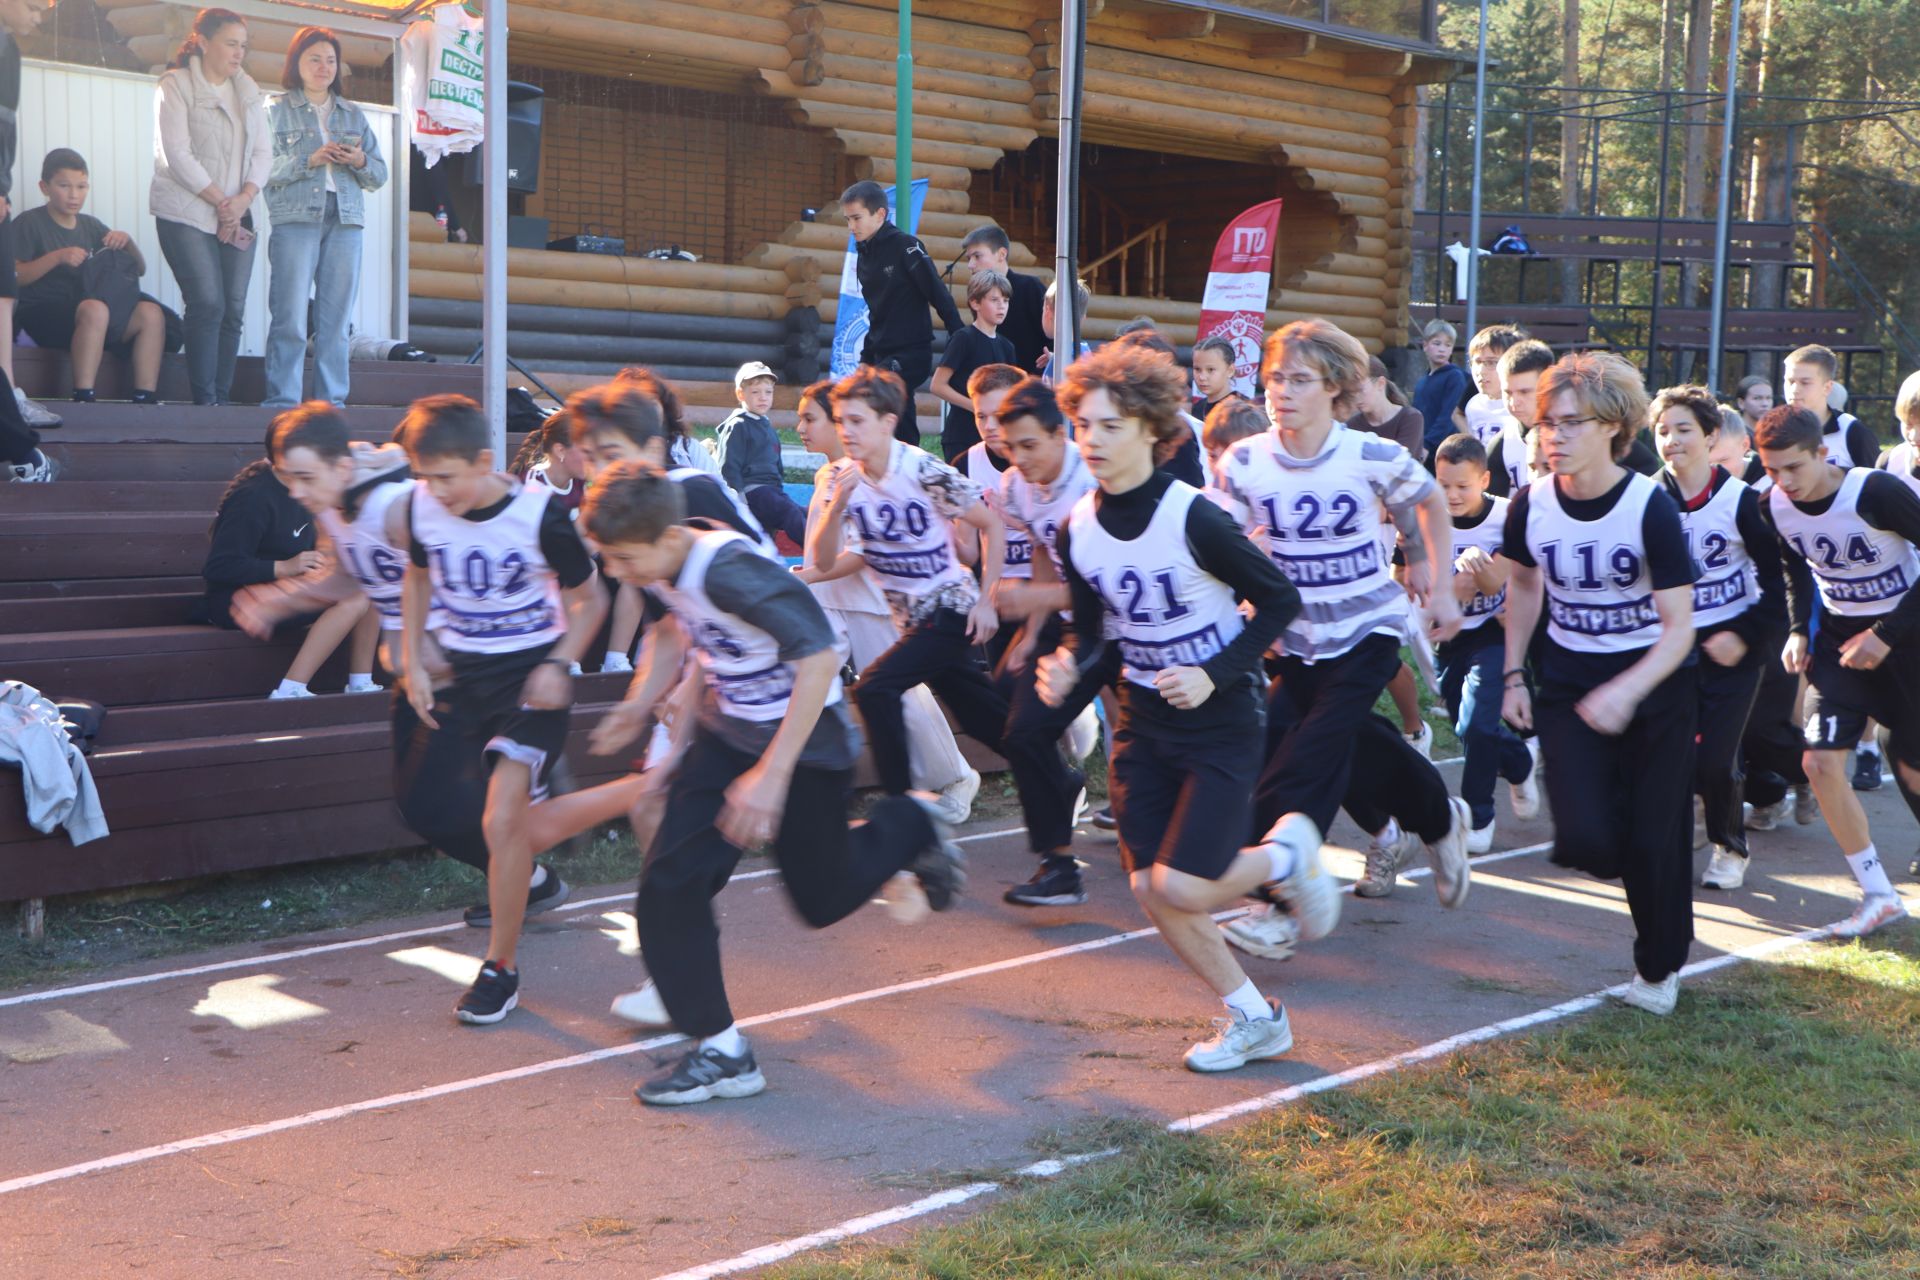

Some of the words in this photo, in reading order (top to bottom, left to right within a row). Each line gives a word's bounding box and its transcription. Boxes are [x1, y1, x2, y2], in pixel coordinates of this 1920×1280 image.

[852, 498, 931, 543] 120
[1258, 490, 1362, 541] 122
[427, 543, 532, 600] 102
[1539, 539, 1645, 592] 119
[1086, 566, 1194, 626] 121
